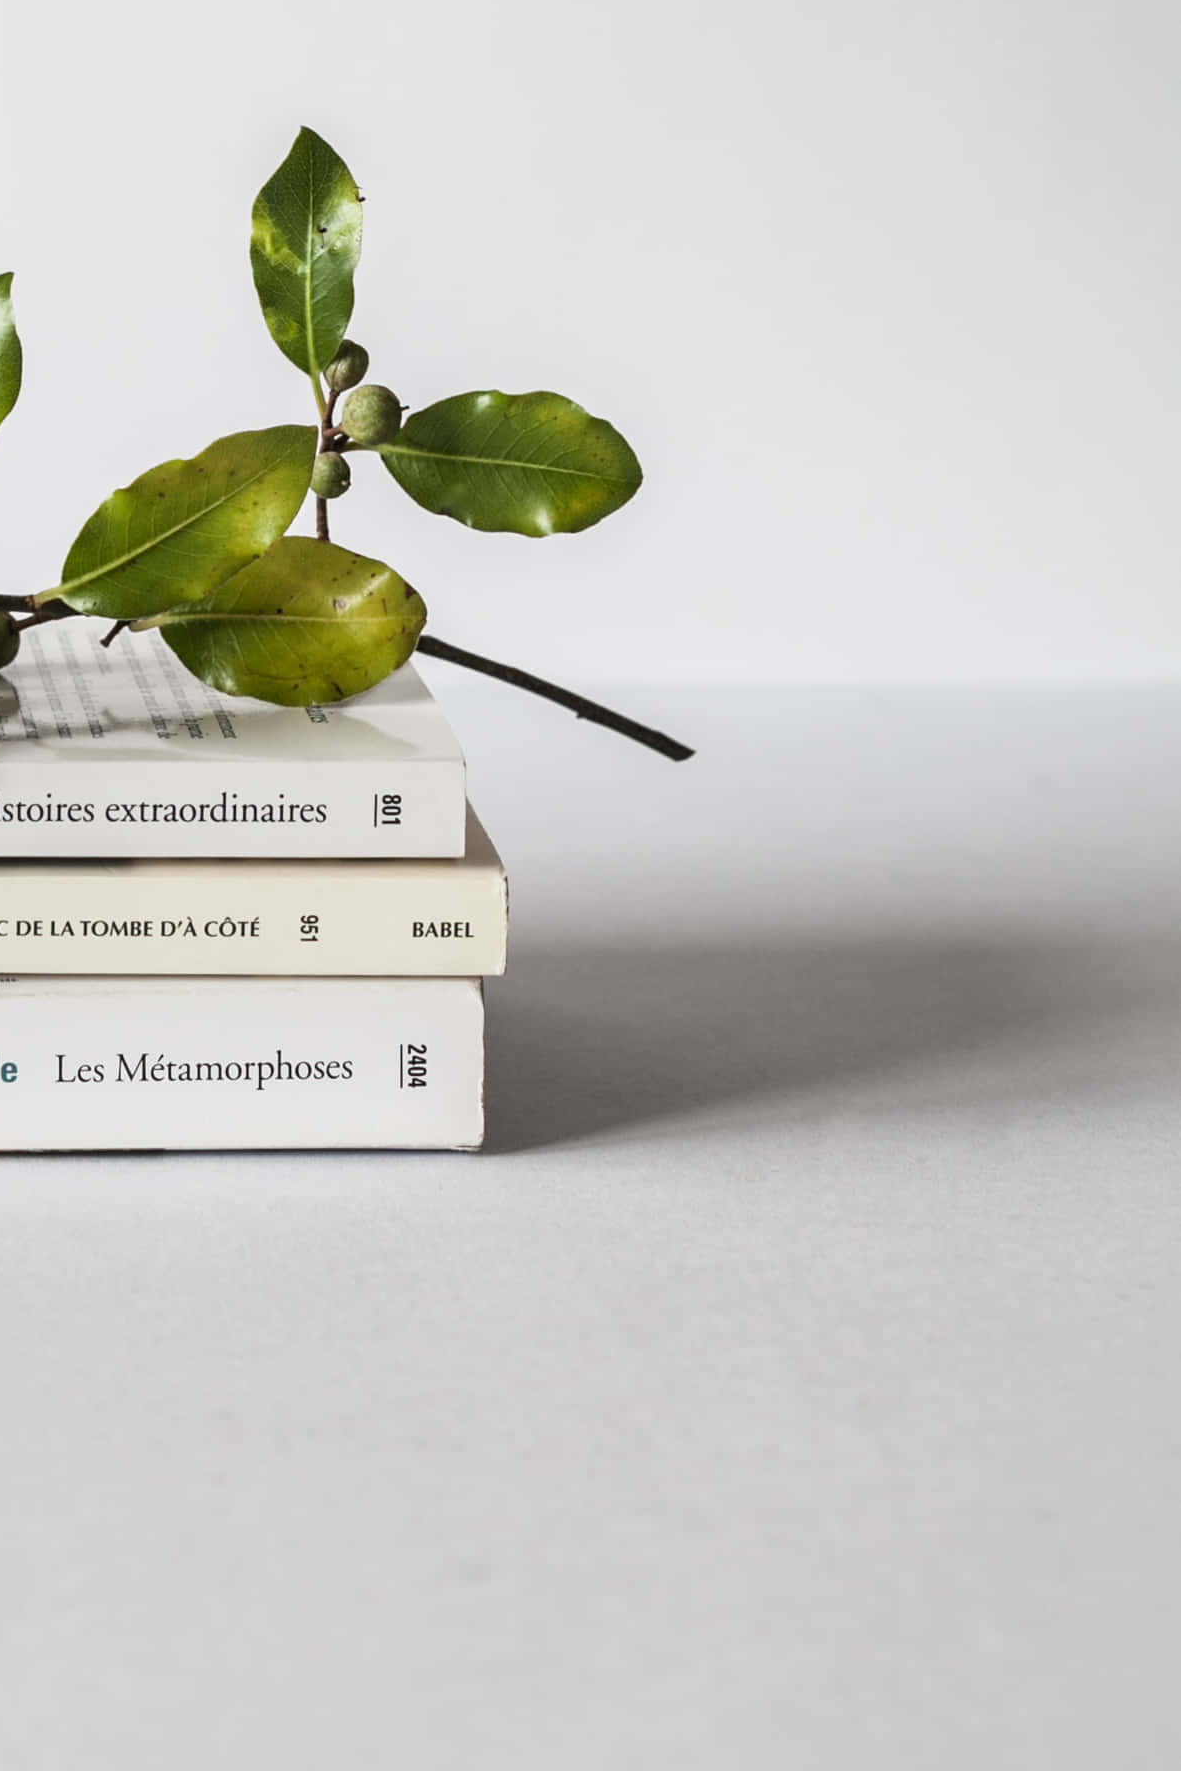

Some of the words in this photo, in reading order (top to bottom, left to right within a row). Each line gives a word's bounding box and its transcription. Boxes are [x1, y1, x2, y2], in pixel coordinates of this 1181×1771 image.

[104, 791, 328, 824] extraordinaires
[380, 793, 403, 827] 801
[15, 919, 44, 937] DE
[50, 919, 76, 937] LA
[79, 919, 154, 938] TOMBE
[160, 915, 198, 938] D'À
[203, 916, 260, 938] CÔTÉ
[299, 914, 320, 944] 951
[411, 921, 476, 939] BABEL
[54, 1054, 105, 1084] Les
[114, 1049, 354, 1092] Métamorphoses
[406, 1043, 428, 1090] 2404
